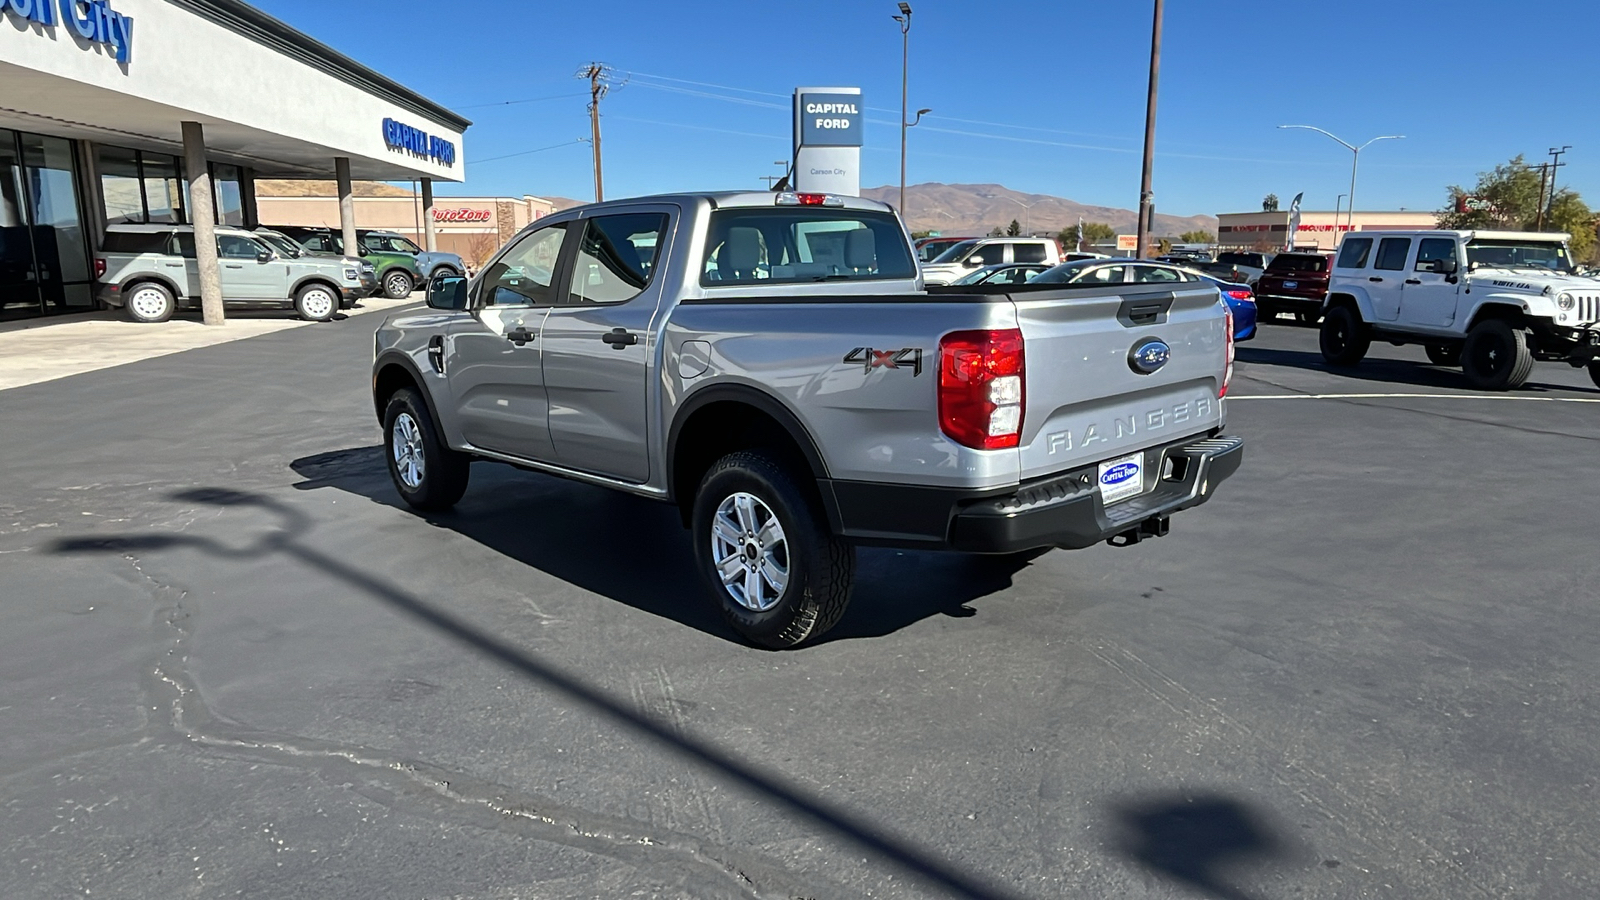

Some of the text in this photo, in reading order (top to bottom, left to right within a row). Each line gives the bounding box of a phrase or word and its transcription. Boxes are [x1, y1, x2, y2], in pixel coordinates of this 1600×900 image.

[60, 0, 133, 63] City
[806, 103, 858, 114] CAPITAL
[816, 119, 850, 129] FORD
[382, 117, 455, 163] CAPITAL FORD
[834, 168, 846, 176] City
[1046, 398, 1211, 456] RANGER
